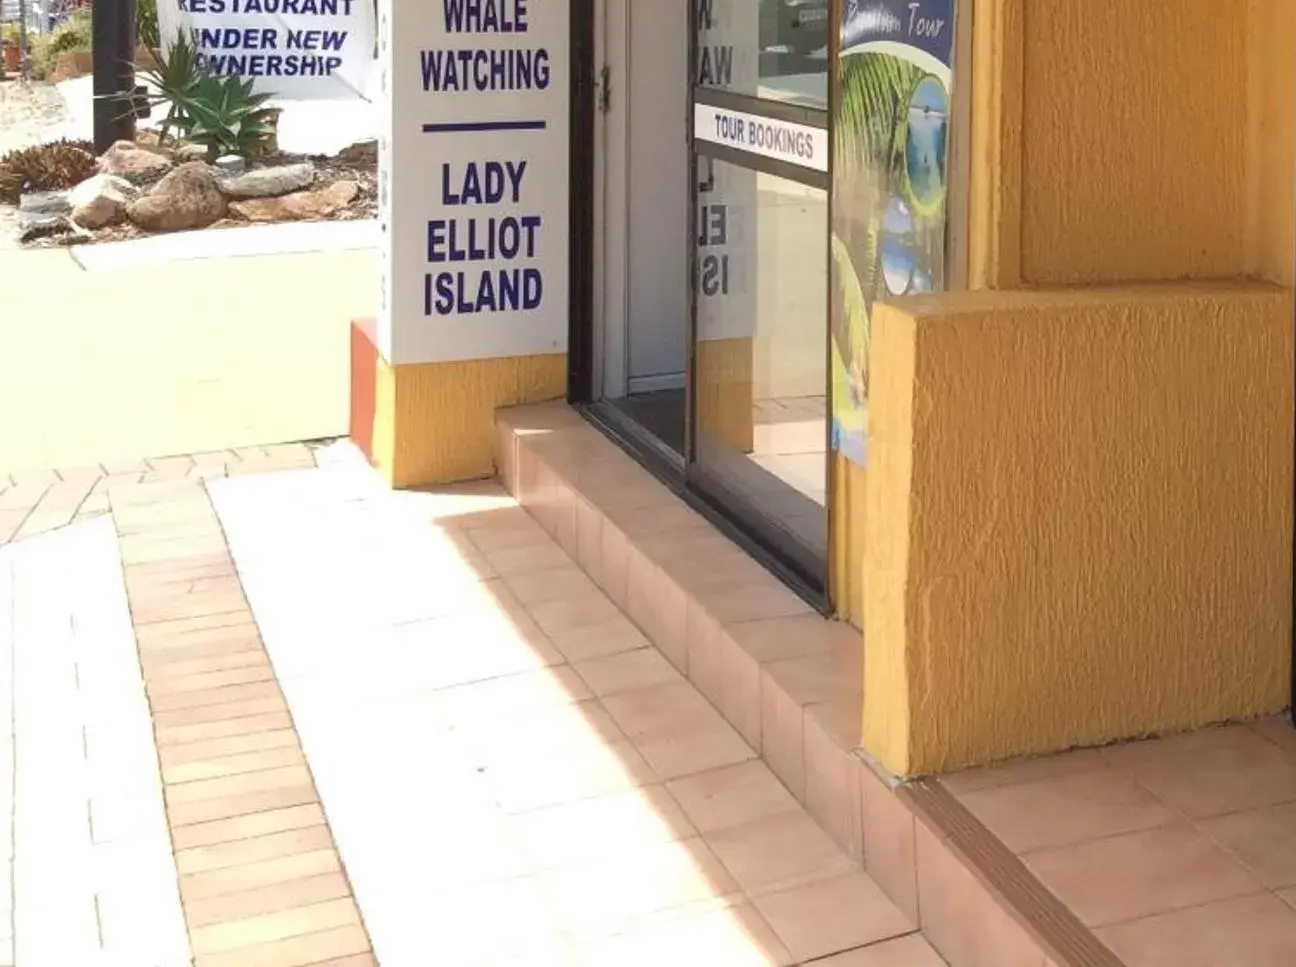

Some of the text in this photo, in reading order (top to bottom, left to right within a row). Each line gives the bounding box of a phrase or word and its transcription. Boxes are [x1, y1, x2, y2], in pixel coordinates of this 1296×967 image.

[288, 29, 347, 51] NEW
[908, 2, 944, 39] Tour
[421, 48, 550, 92] WATCHING
[715, 114, 814, 160] TOUR BOOKINGS
[442, 161, 527, 206] LADY
[427, 216, 541, 263] ELLIOT
[424, 268, 543, 316] ISLAND
